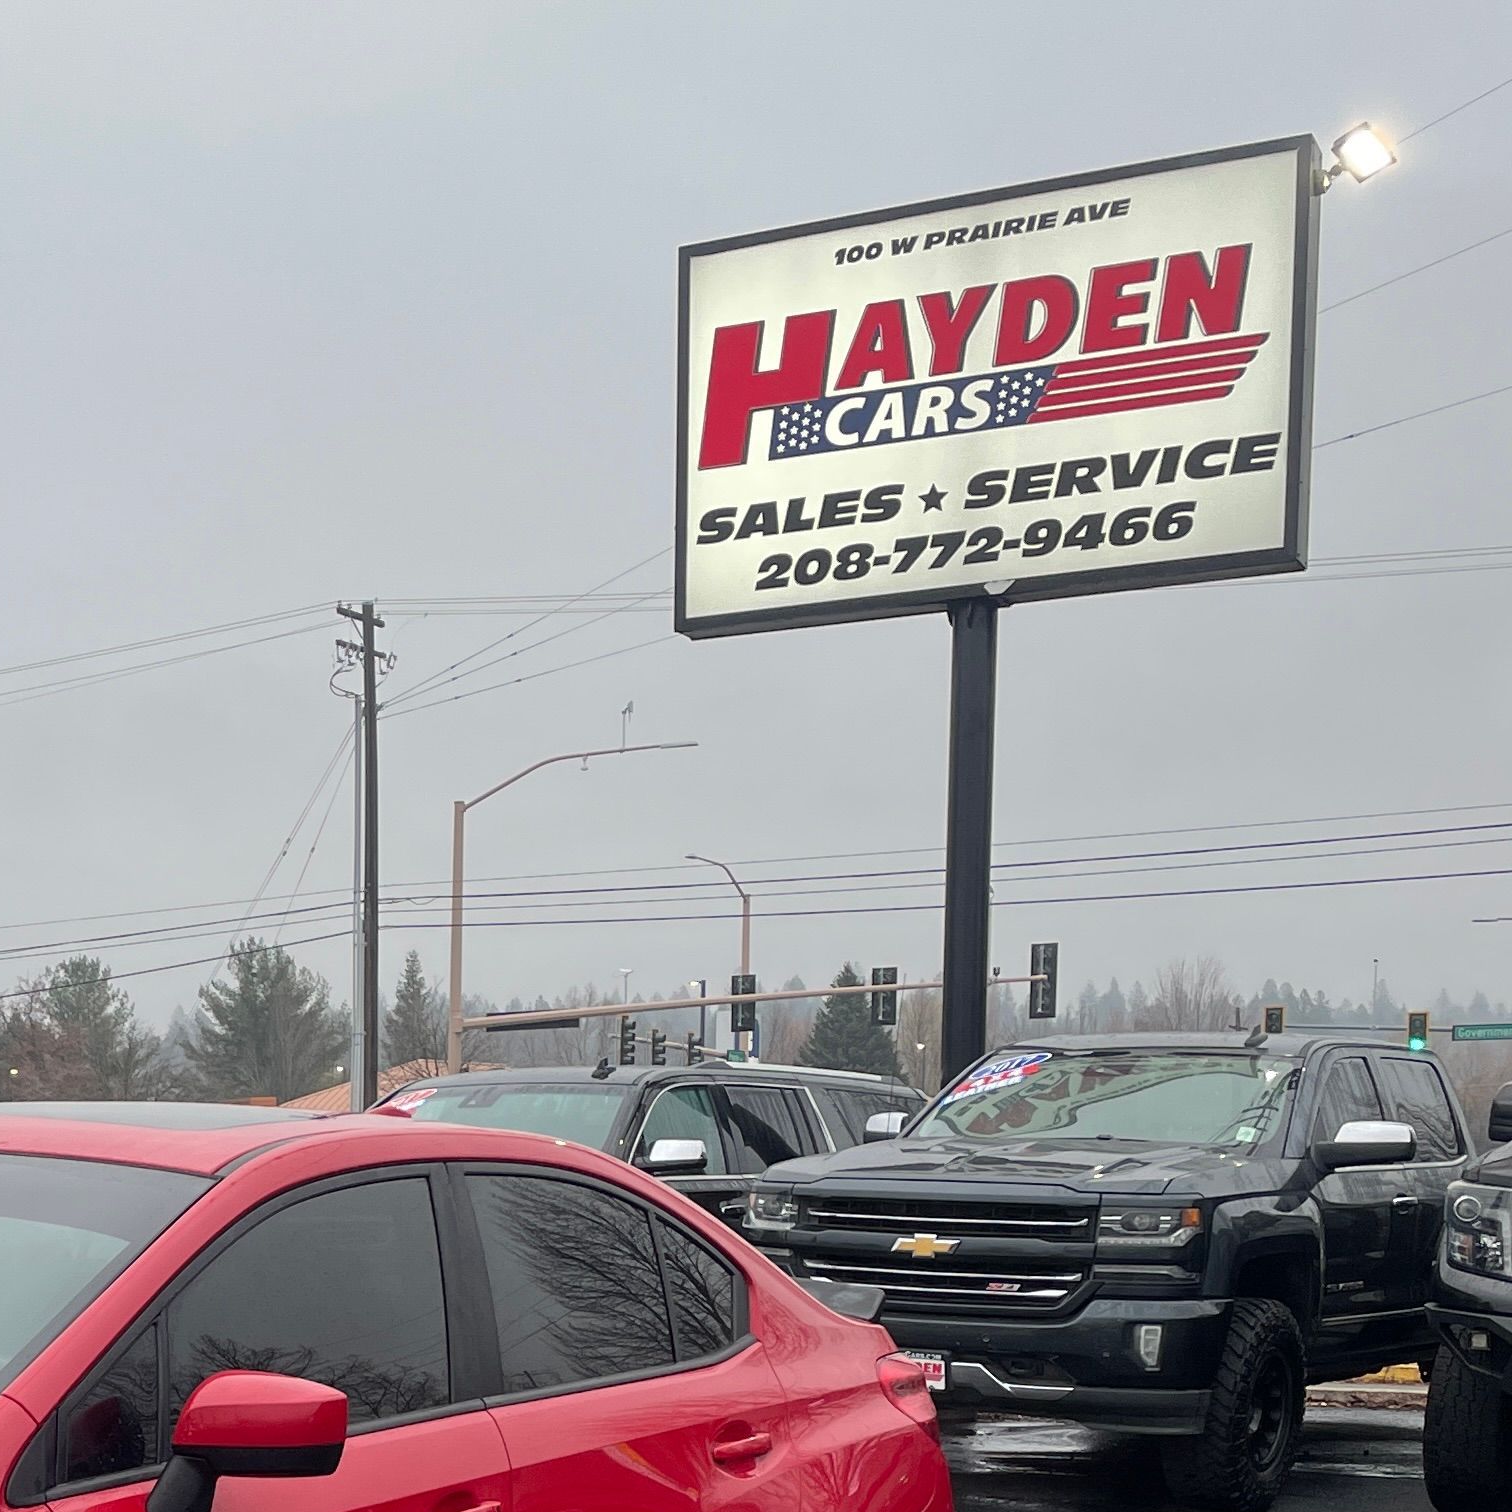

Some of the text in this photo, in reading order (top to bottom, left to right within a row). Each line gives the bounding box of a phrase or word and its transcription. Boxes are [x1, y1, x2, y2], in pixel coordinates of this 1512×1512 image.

[834, 199, 1131, 266] 100 W PRAIRIE AVE
[697, 242, 1253, 471] HAYDEN
[824, 378, 994, 447] CARS
[696, 432, 1283, 545] SALES SERVICE
[754, 501, 1197, 591] 208-772-9466
